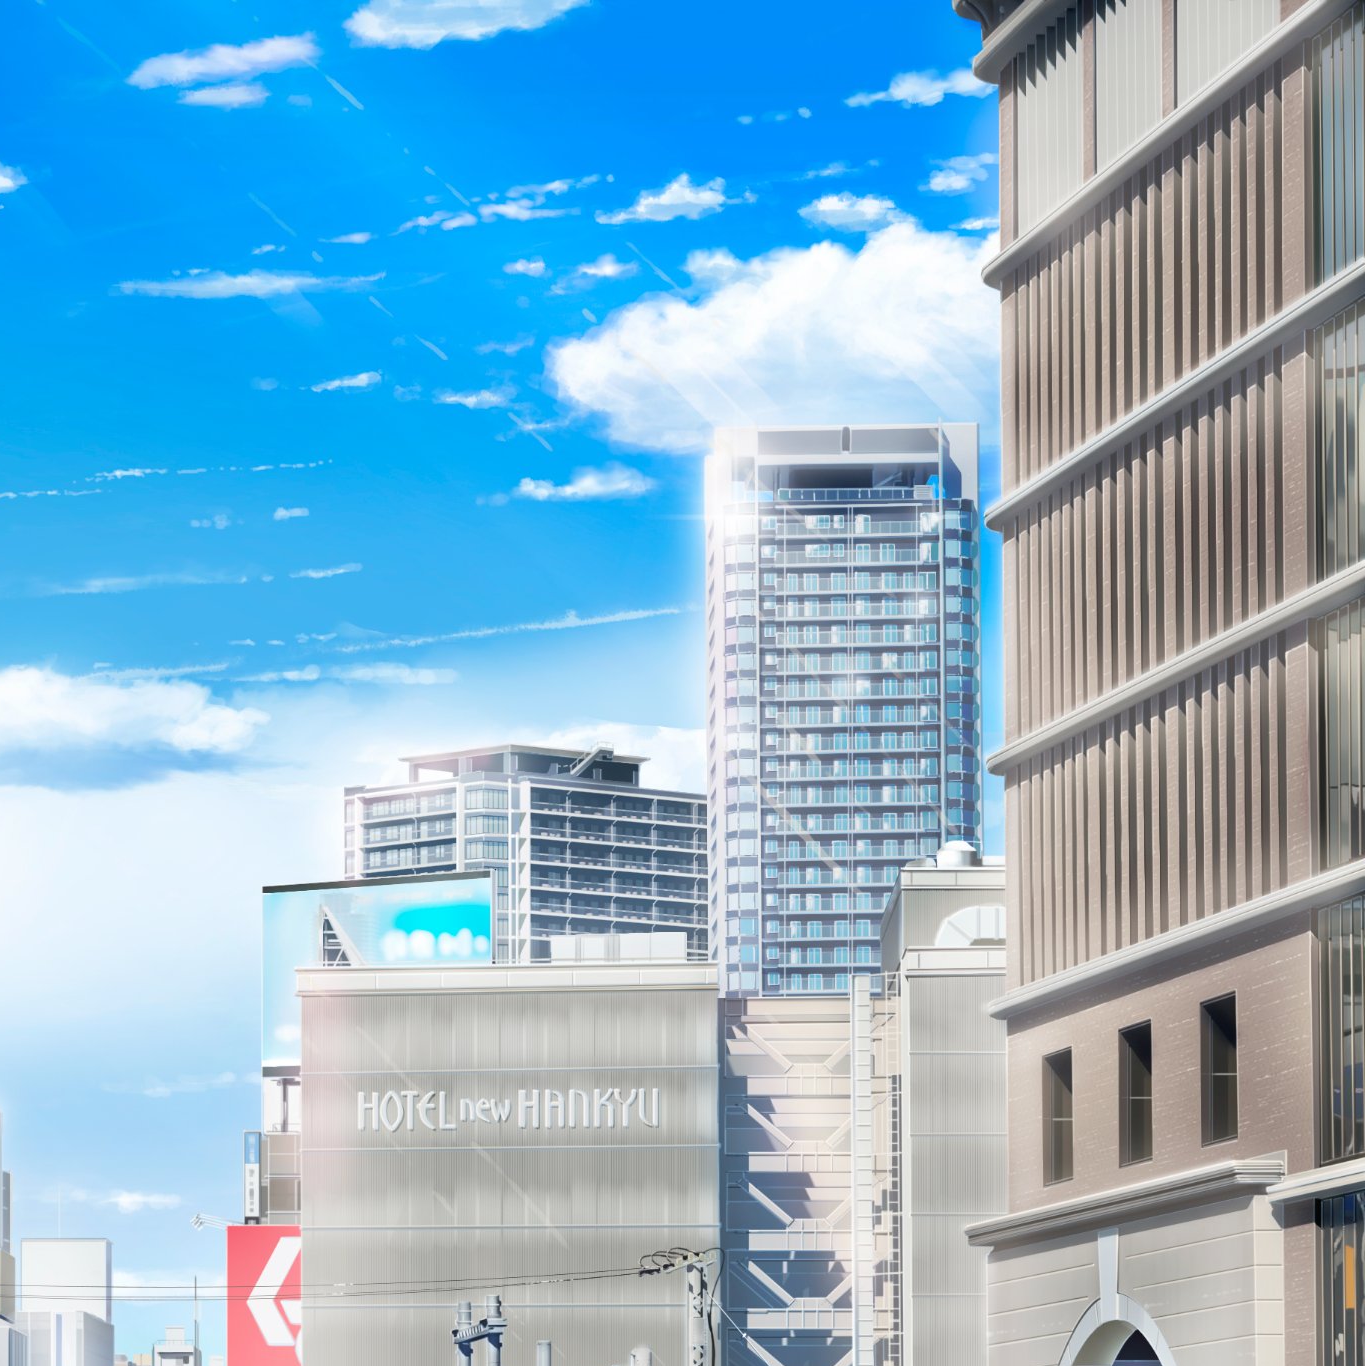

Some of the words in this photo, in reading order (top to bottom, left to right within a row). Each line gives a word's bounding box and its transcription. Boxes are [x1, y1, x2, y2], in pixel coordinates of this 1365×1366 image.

[357, 1090, 457, 1132] HOTEL
[459, 1098, 512, 1123] new
[518, 1088, 660, 1129] HANKYU
